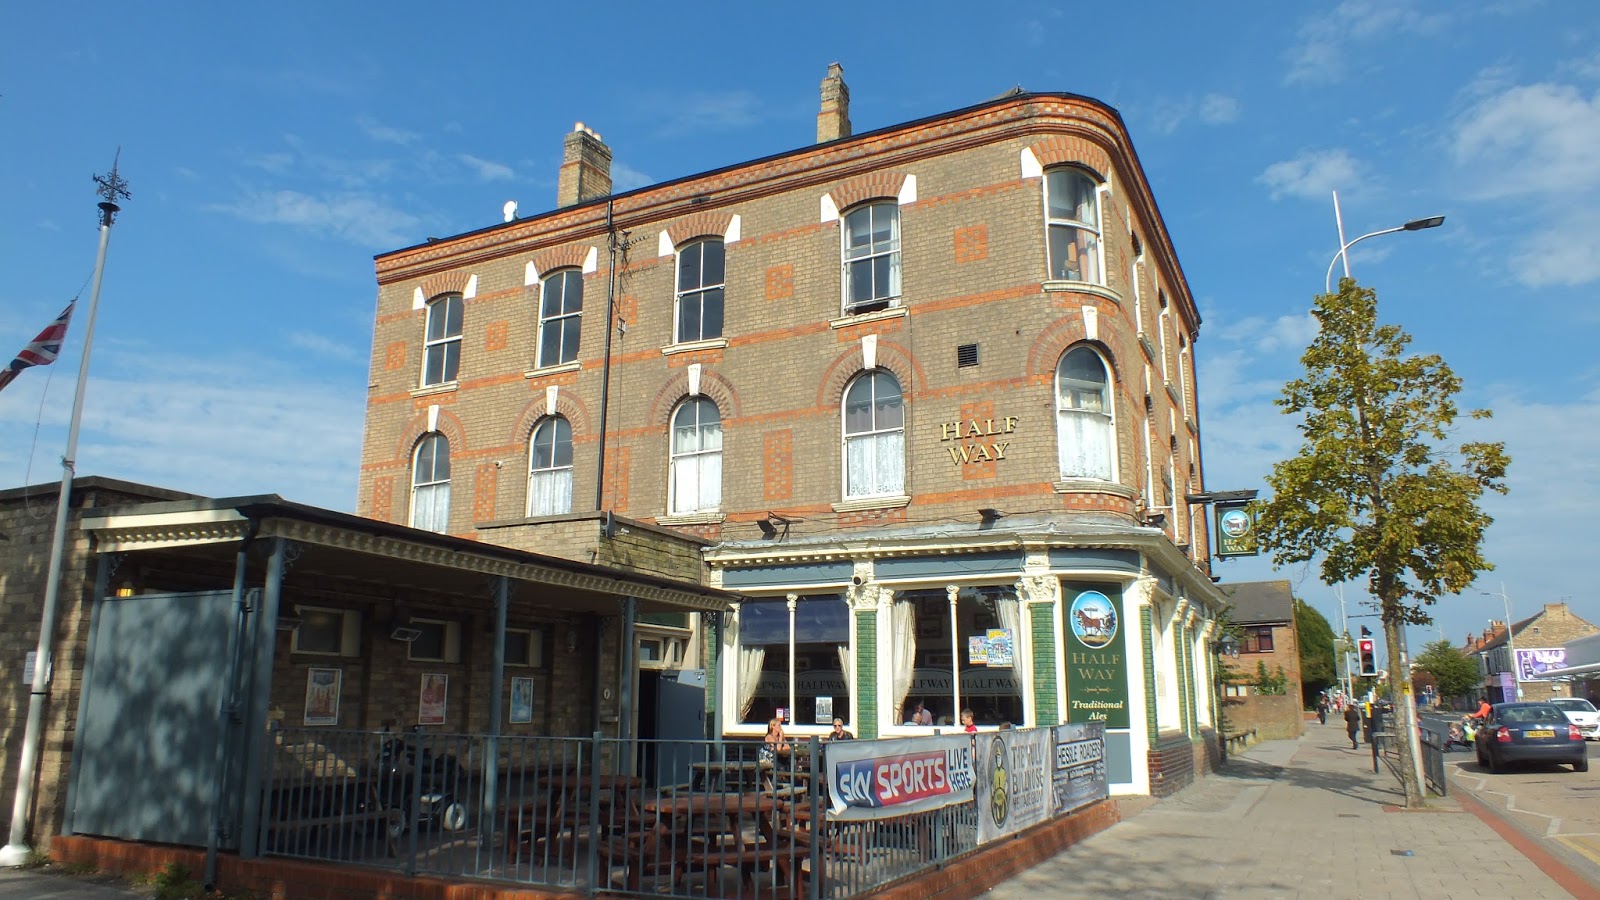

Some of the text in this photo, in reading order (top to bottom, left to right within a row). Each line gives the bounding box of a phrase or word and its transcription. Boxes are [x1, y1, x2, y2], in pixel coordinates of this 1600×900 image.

[940, 416, 1019, 441] HALF
[947, 442, 1009, 465] WAY
[1072, 652, 1120, 665] HALF
[1078, 667, 1116, 680] WAY
[797, 680, 847, 690] HALFWAY
[962, 678, 1019, 689] HALFWAY
[1072, 700, 1123, 709] Traditional
[1088, 711, 1108, 720] Ales
[949, 747, 968, 769] LIVE
[1011, 745, 1025, 770] THE
[877, 757, 945, 800] SPORTS
[949, 771, 972, 793] HERE
